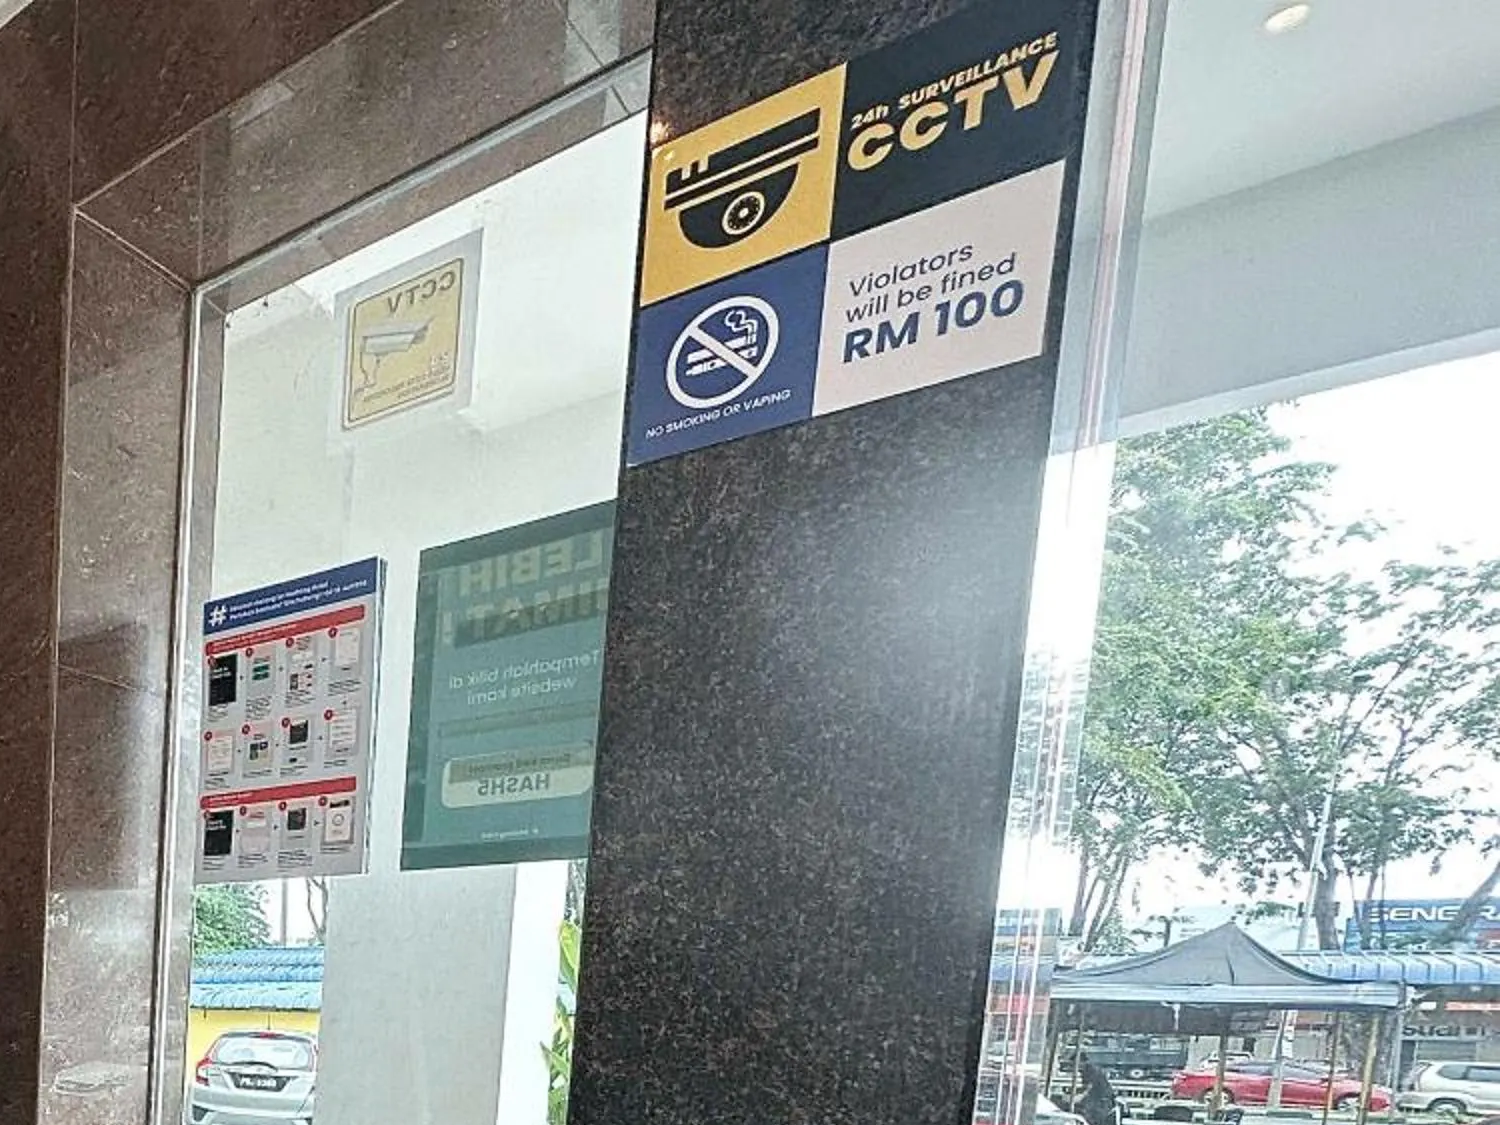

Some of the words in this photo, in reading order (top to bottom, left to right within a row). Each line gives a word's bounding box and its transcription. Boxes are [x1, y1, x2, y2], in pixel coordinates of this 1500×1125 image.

[847, 50, 1059, 171] CCTV
[851, 102, 889, 128] 24h
[897, 32, 1058, 111] SURVEILLANCE
[846, 294, 888, 324] will
[897, 275, 932, 307] be
[941, 252, 1015, 296] fined
[849, 244, 973, 298] Violators
[843, 311, 917, 364] RM
[936, 279, 1025, 338] 100
[665, 409, 721, 433] SMOKING
